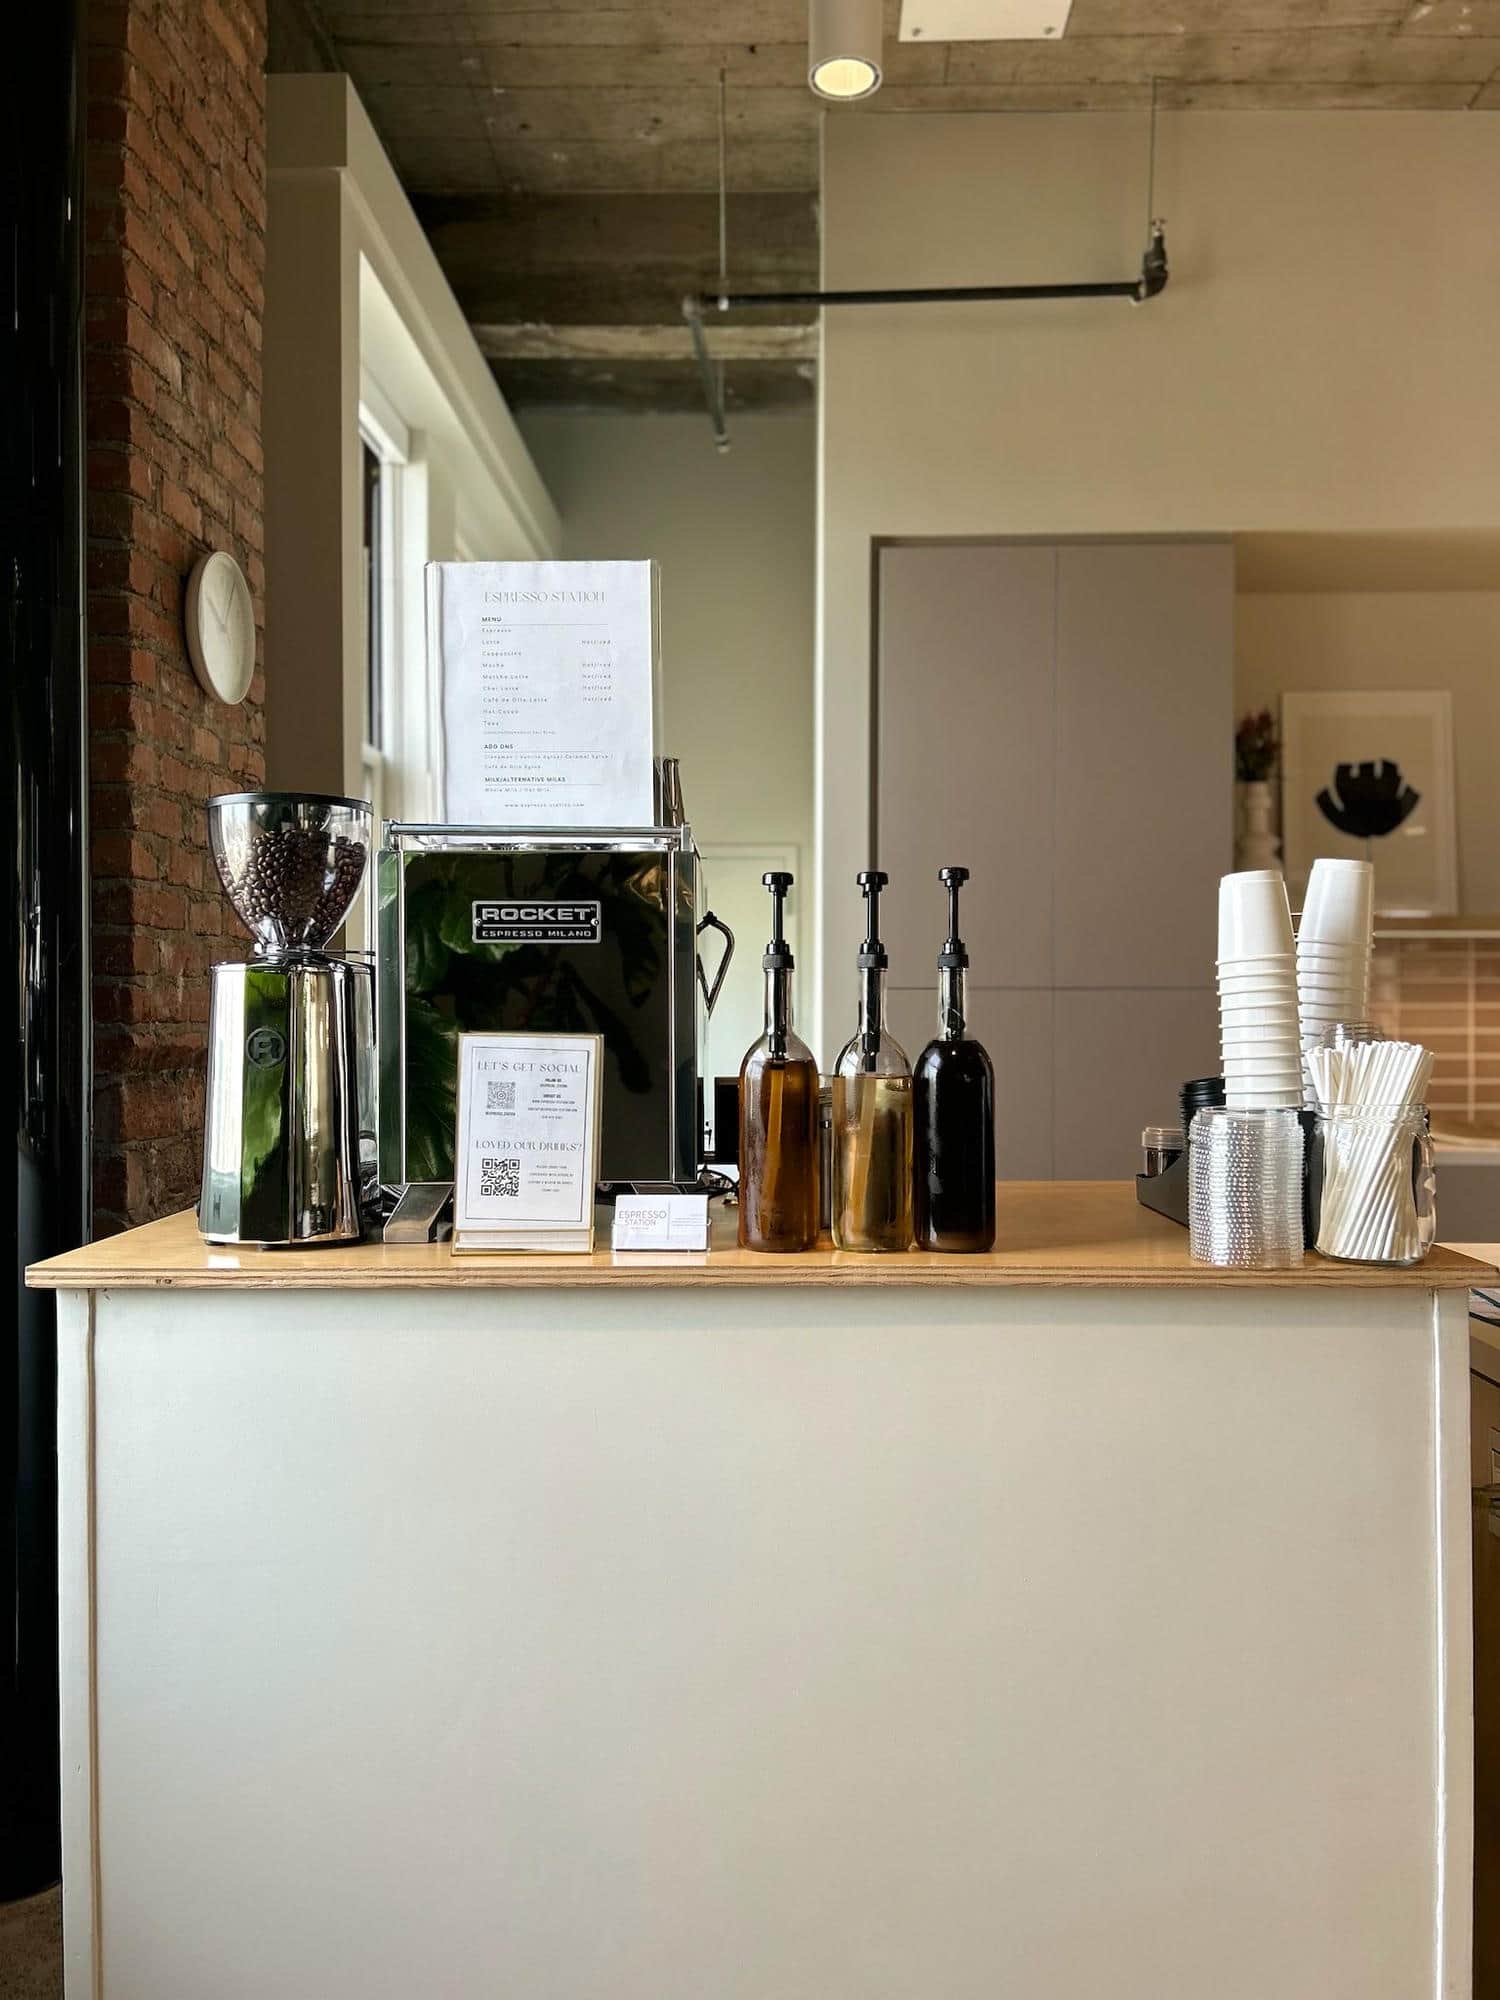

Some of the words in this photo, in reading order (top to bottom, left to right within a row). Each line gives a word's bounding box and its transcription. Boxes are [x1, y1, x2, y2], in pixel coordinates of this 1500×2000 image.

[482, 908, 591, 921] ROCKET
[513, 1062, 537, 1072] GET
[539, 1063, 581, 1074] SOCIAL
[475, 1140, 511, 1150] LOVED
[514, 1141, 537, 1150] OUR
[618, 1210, 668, 1219] ESPRESSO
[624, 1219, 657, 1227] STATION
